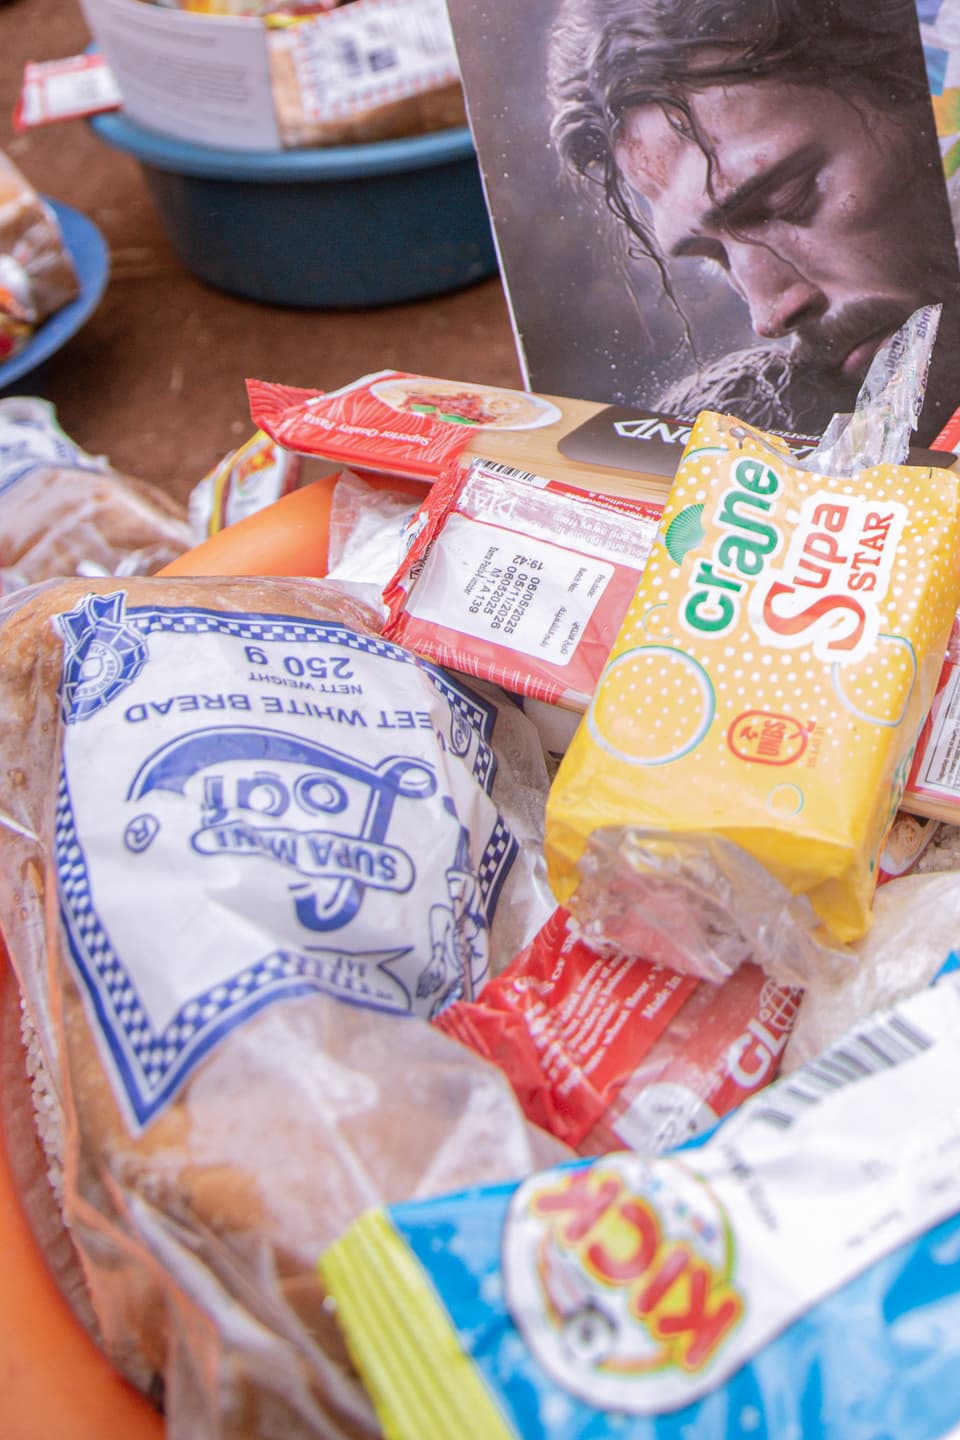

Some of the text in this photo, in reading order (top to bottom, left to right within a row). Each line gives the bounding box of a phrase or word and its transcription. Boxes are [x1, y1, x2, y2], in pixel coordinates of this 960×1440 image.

[510, 549, 545, 576] 19:42
[684, 459, 781, 633] crane
[847, 511, 895, 592] STAR
[479, 583, 491, 595] A
[764, 503, 866, 652] Supa
[467, 592, 485, 615] 139
[489, 570, 529, 632] 05/11/2026
[502, 574, 541, 636] 06/05/2025
[244, 644, 356, 680] 250 g
[249, 671, 363, 697] NETT WEIGHT
[124, 691, 251, 723] BREAD
[260, 694, 367, 727] WHITE
[309, 838, 399, 880] SUPA
[530, 1165, 745, 1372] KICK
